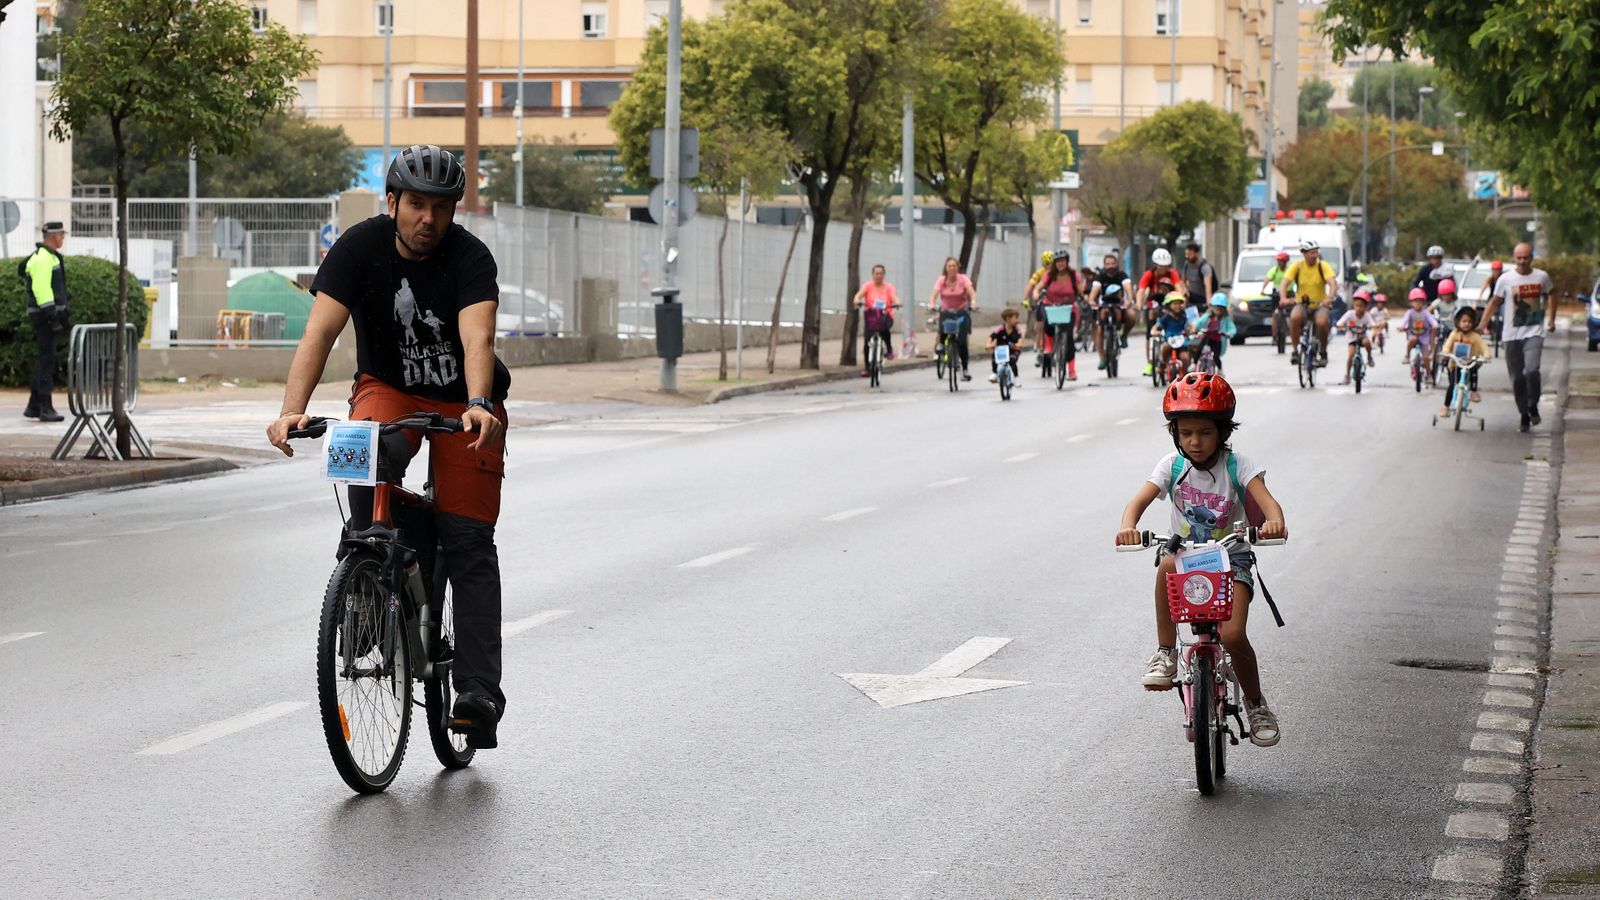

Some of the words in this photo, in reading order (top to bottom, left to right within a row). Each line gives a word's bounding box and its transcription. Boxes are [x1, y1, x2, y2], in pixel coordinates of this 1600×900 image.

[399, 340, 453, 360] WALKING
[402, 353, 458, 387] DAD
[1197, 558, 1218, 567] AMISTAD
